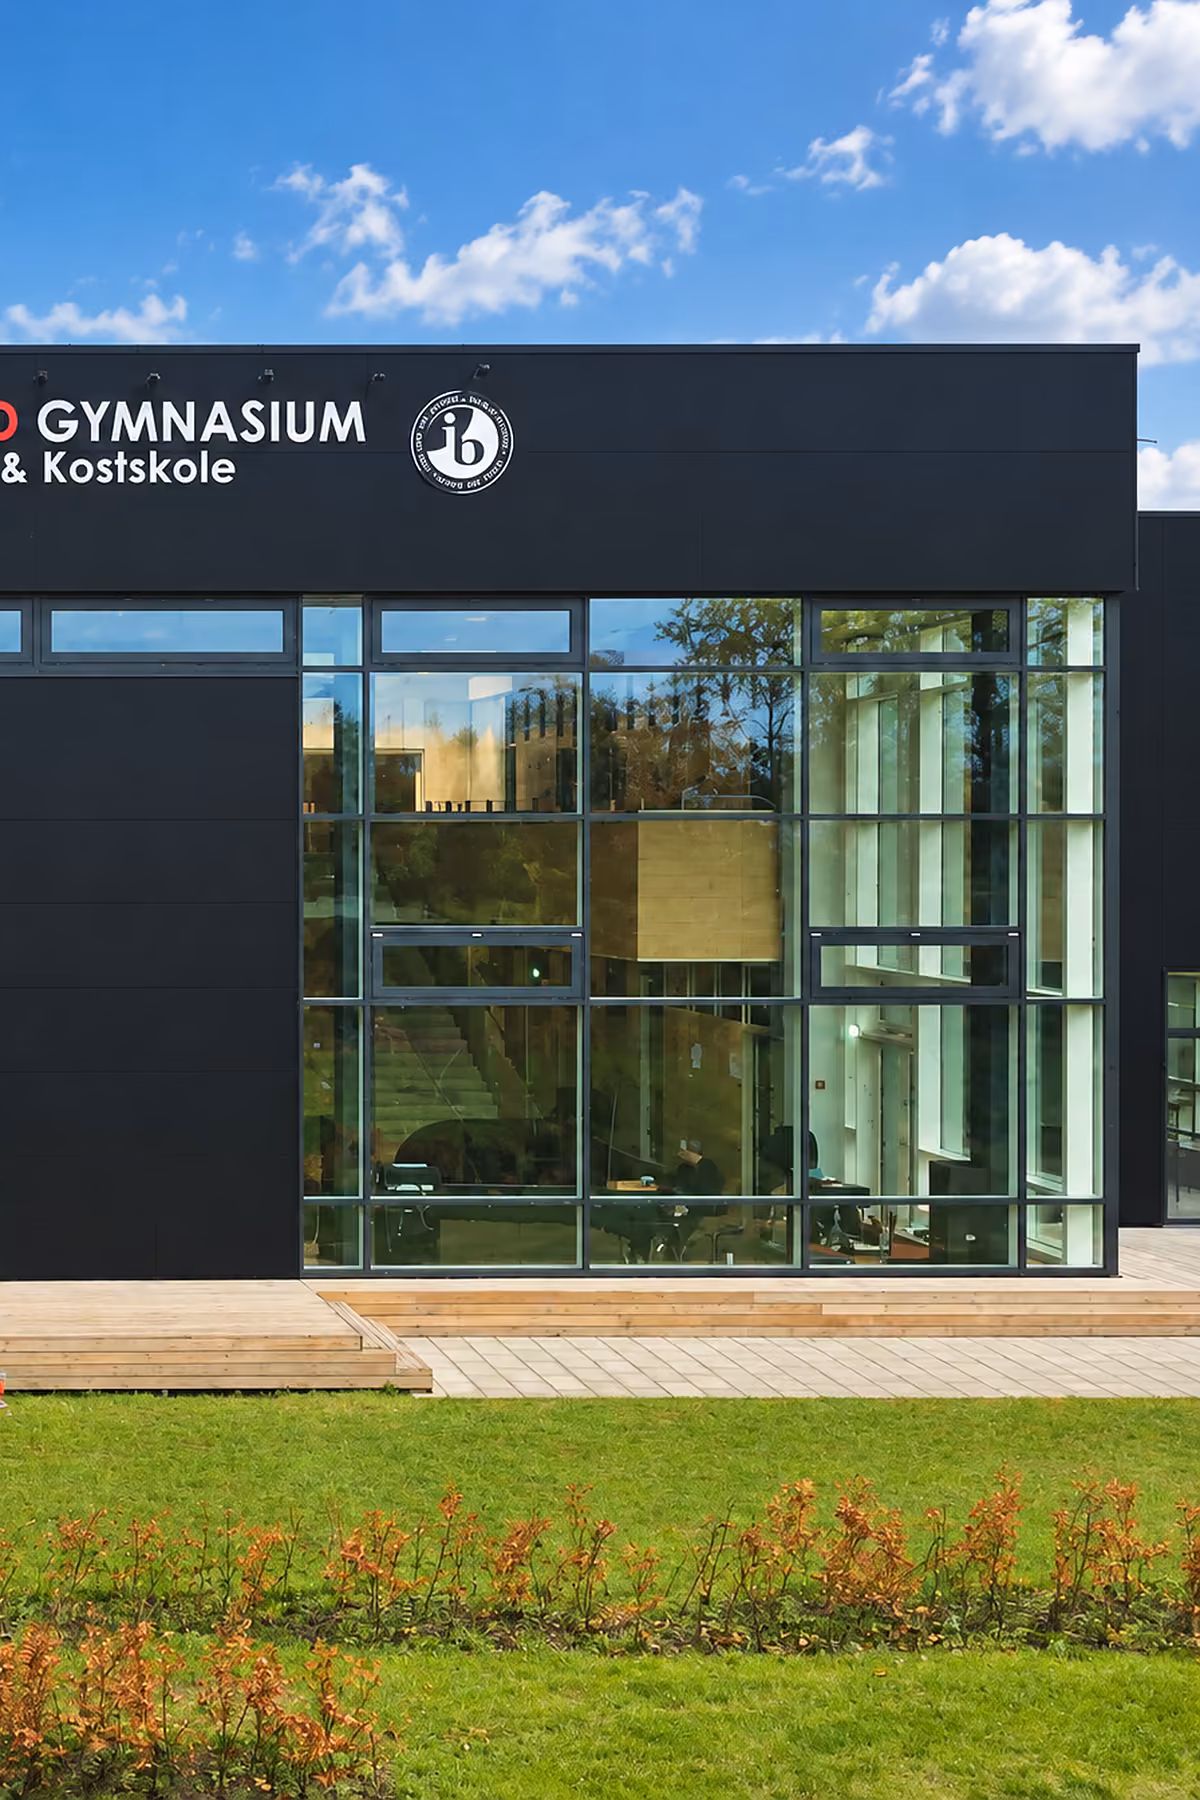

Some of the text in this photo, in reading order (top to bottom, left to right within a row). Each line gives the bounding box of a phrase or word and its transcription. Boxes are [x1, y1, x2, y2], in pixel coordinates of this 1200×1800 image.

[37, 399, 366, 443] GYMNASIUM
[0, 452, 28, 484] &
[43, 450, 236, 484] Kostskole
